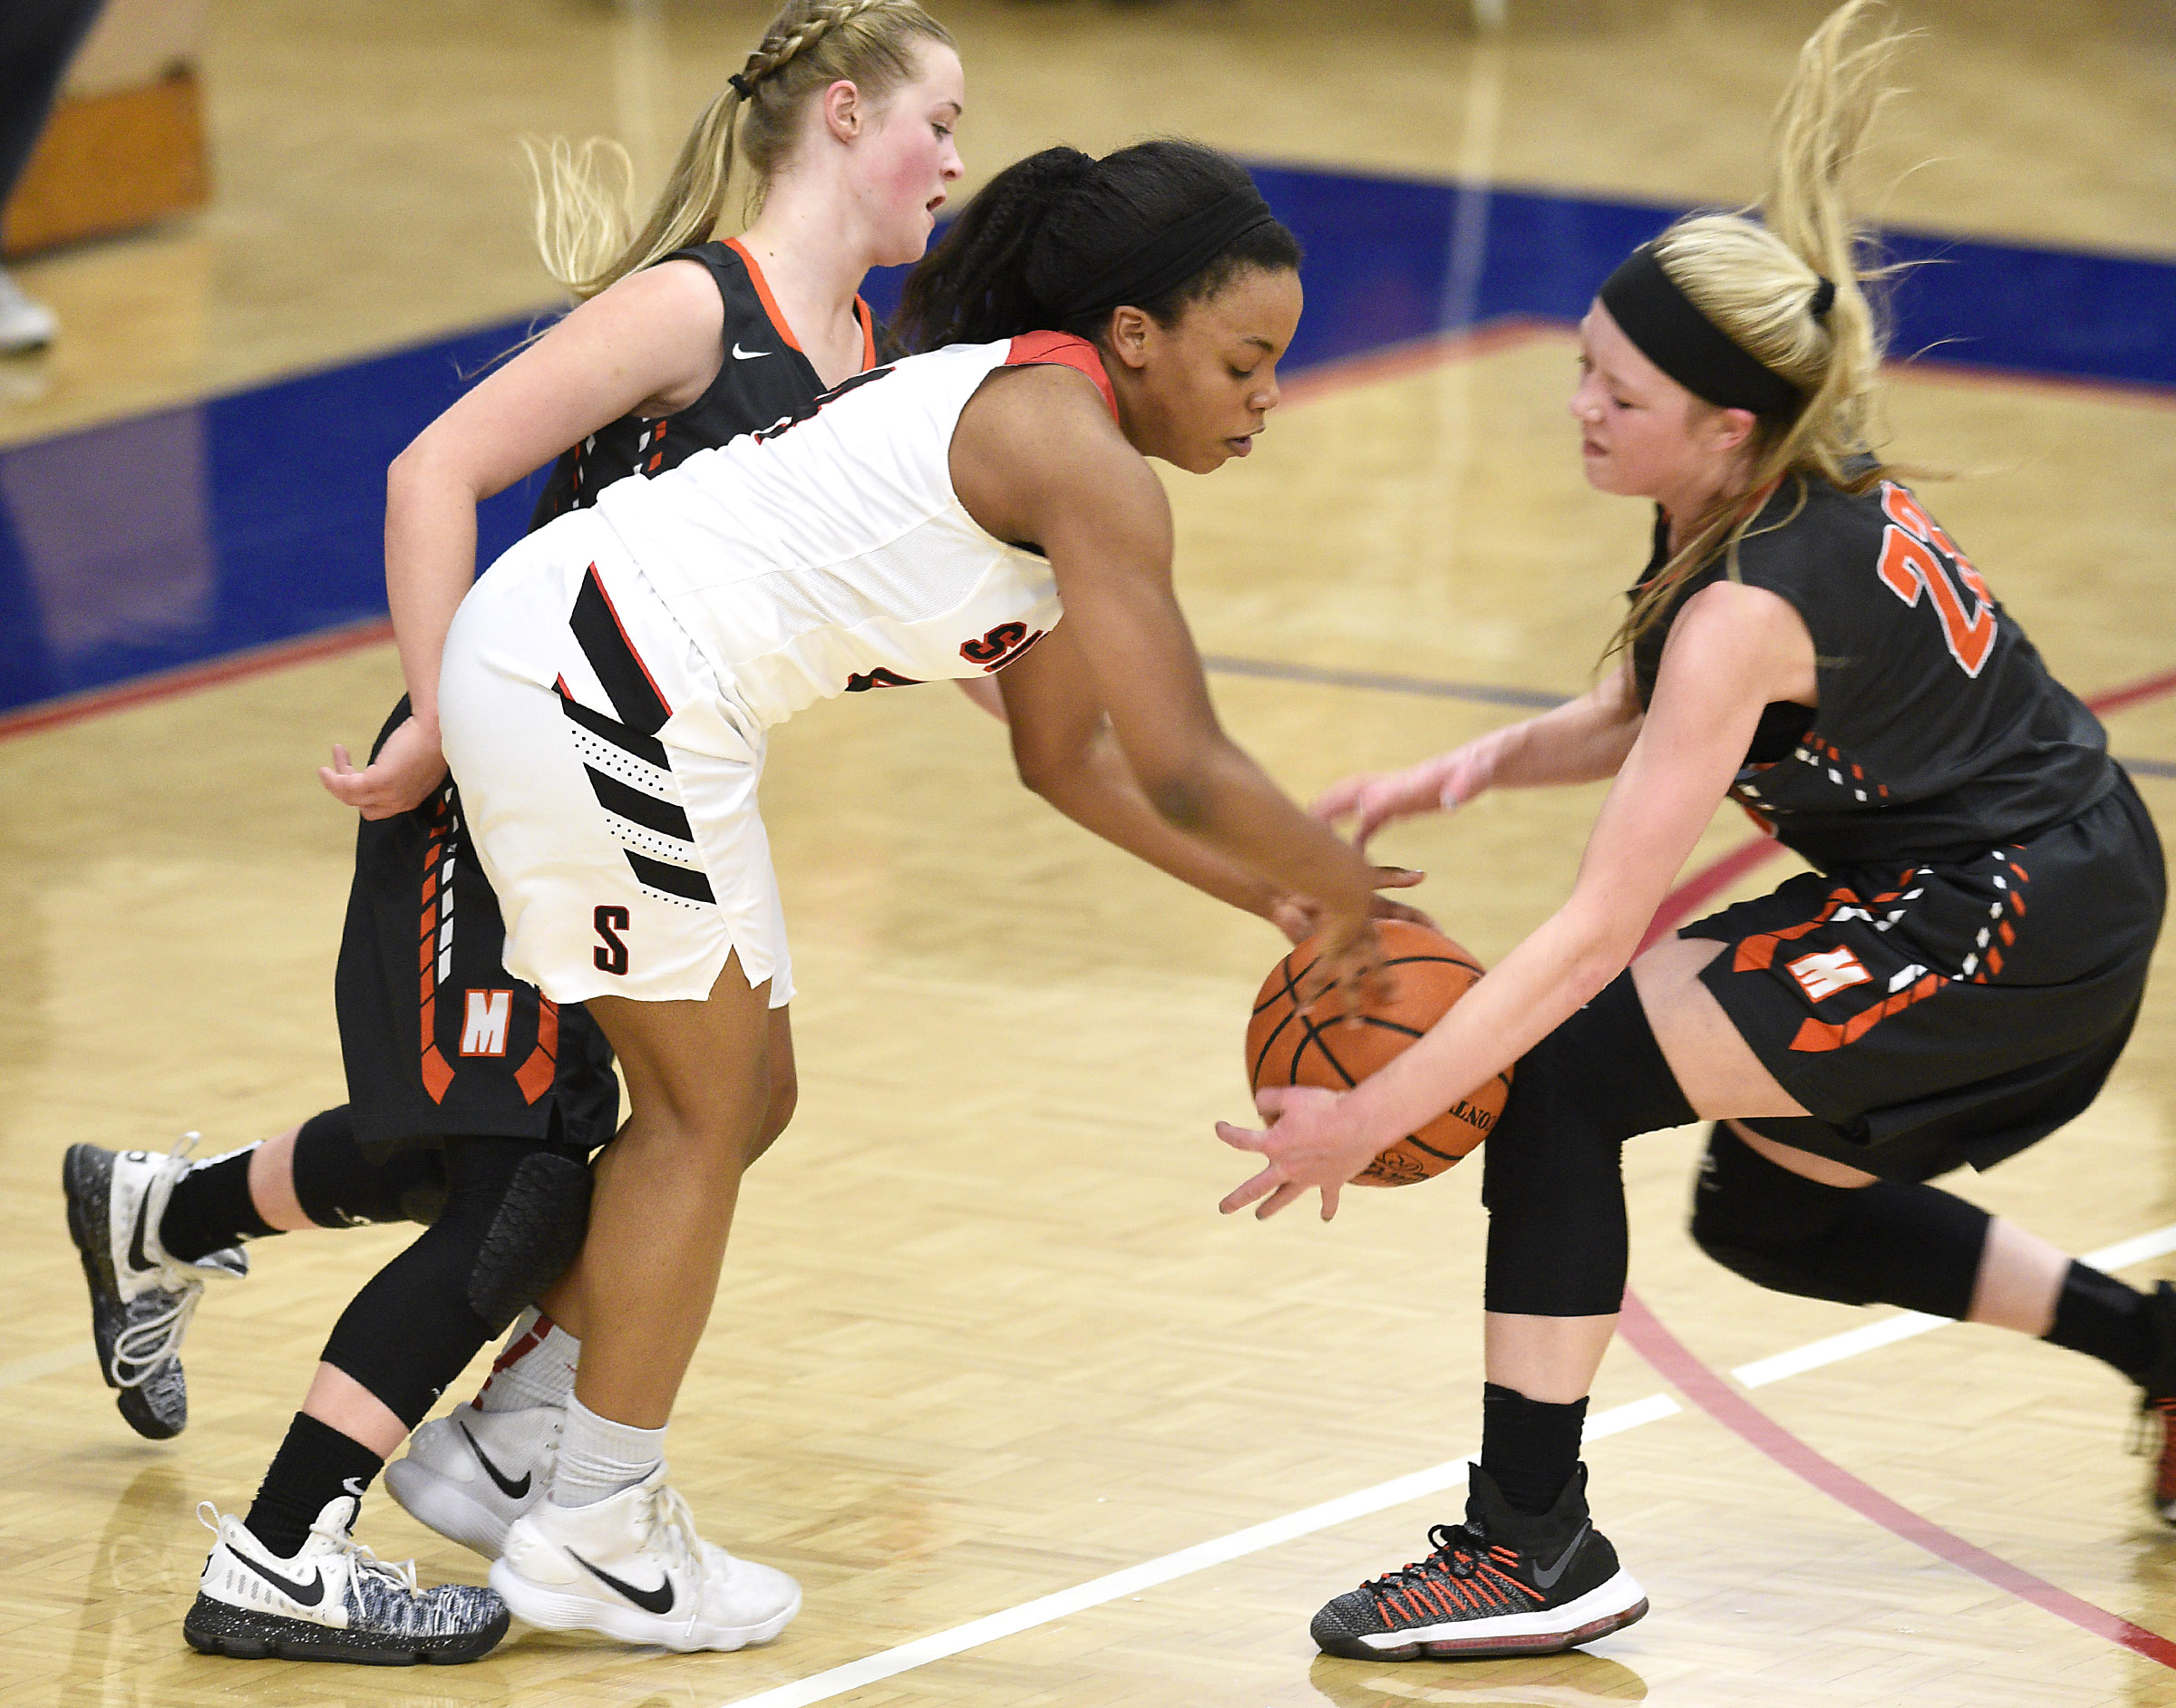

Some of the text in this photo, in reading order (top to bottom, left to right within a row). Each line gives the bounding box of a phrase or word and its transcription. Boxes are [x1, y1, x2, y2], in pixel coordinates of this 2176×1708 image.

[594, 905, 629, 975] S
[1783, 944, 1874, 1004] M
[459, 989, 514, 1057] M
